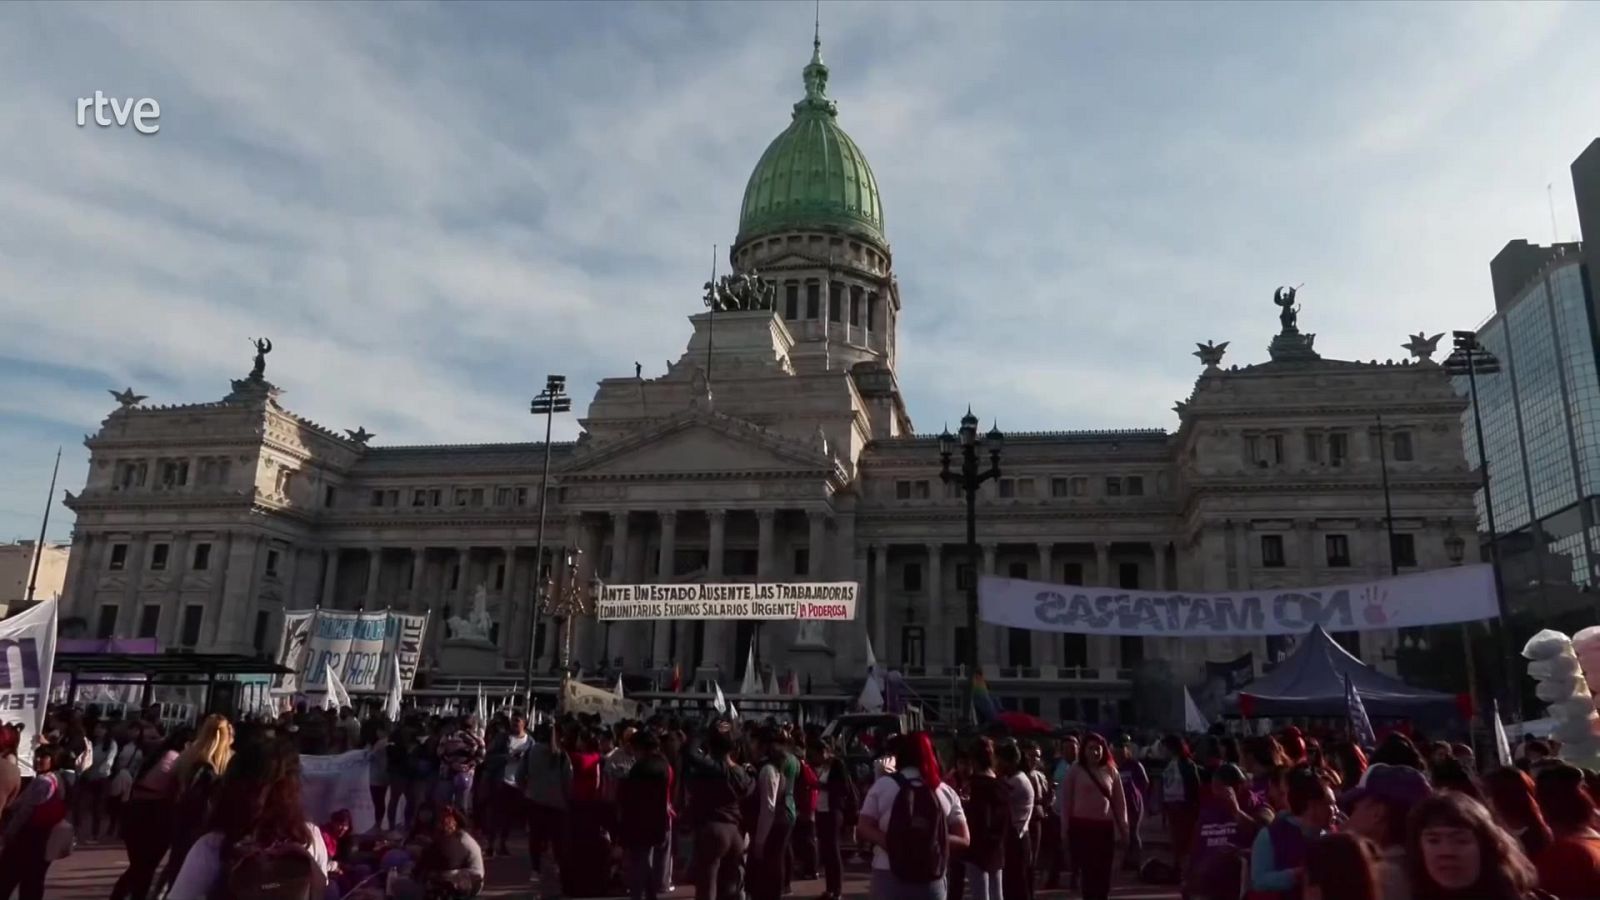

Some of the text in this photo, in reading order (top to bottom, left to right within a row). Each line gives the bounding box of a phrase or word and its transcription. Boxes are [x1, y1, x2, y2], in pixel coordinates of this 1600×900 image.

[601, 585, 631, 601] ANTE
[650, 585, 697, 601] ESTADO
[755, 583, 775, 600] LAS
[776, 583, 854, 601] TRABAJADORAS
[600, 603, 661, 618] COMUNITARIAS
[664, 602, 701, 616] EXIGIMOS
[702, 602, 748, 616] SALARIOS
[808, 603, 847, 618] PODEROSA
